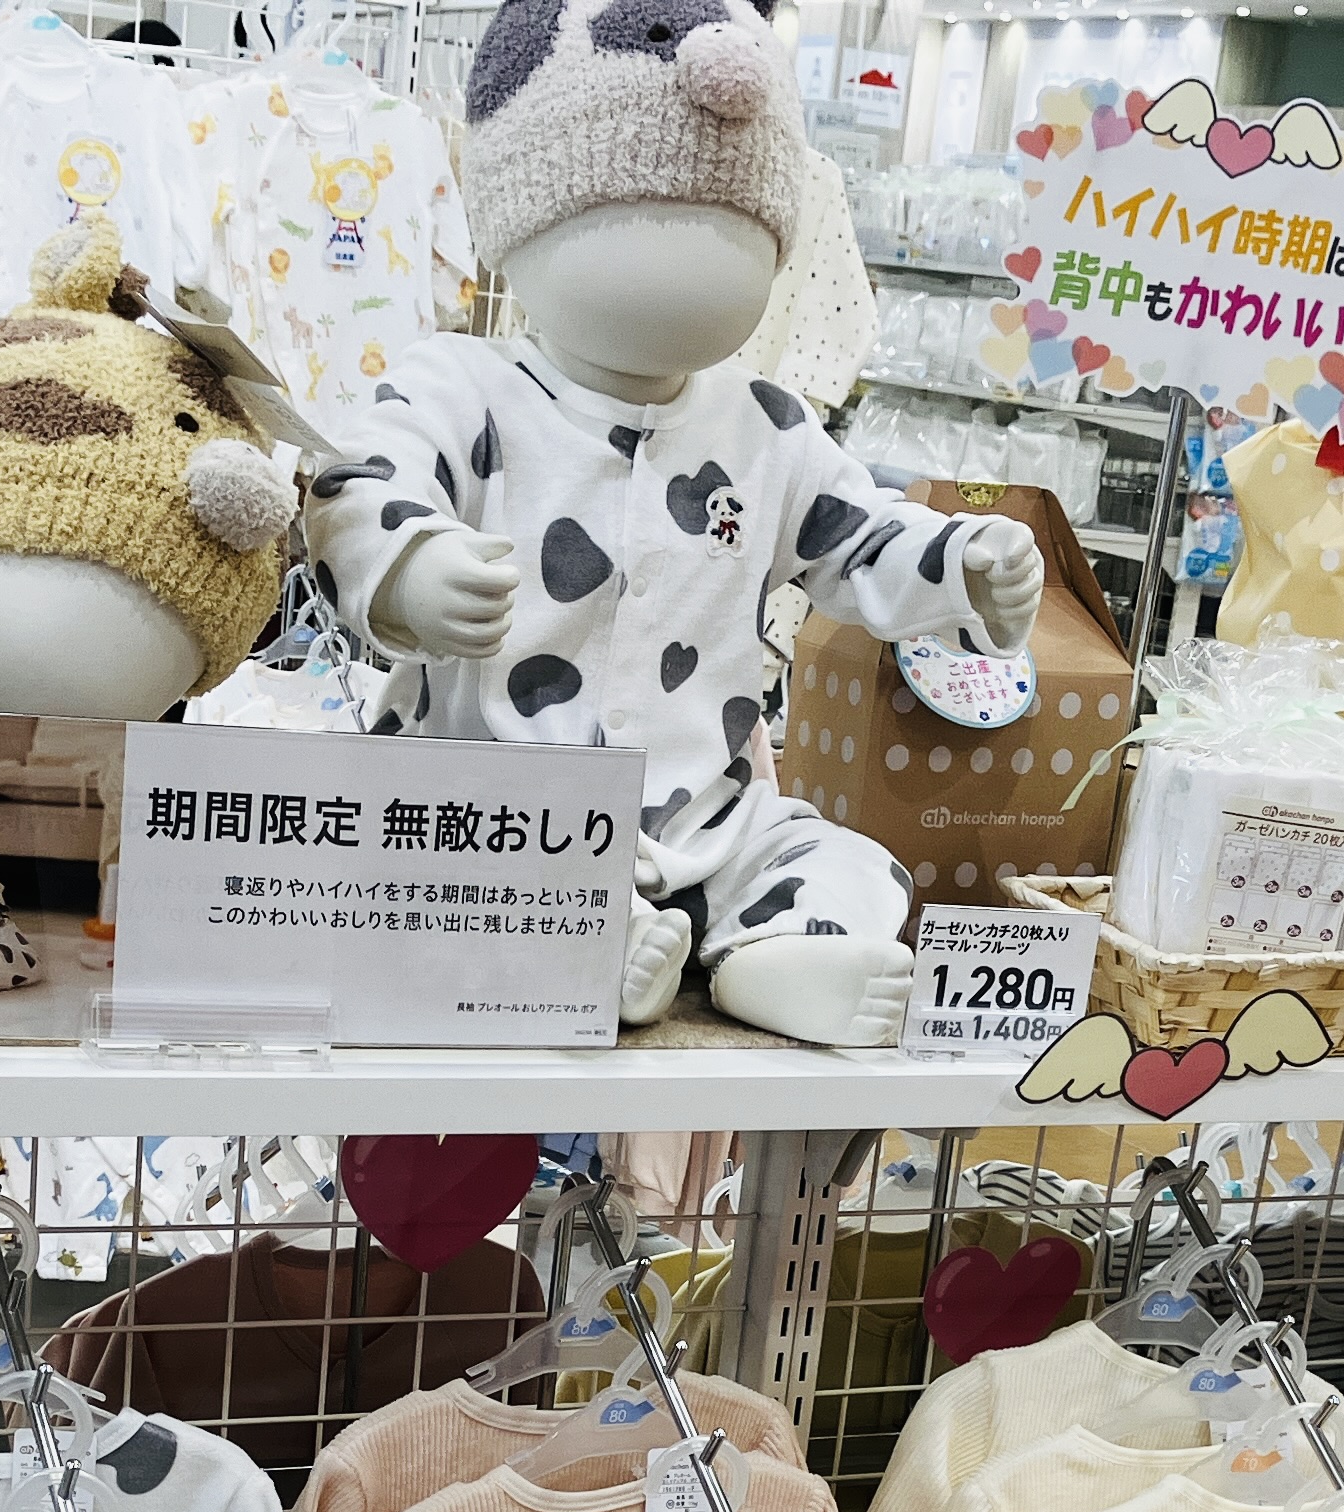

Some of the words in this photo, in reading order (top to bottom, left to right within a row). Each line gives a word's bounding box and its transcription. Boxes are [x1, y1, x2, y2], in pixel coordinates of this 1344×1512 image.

[948, 659, 992, 677] ご出産
[947, 676, 1003, 693] おめでとう
[952, 688, 1008, 705] ございます
[145, 787, 362, 848] 期間限定
[380, 798, 616, 858] 無敵おしり
[953, 811, 1016, 826] akachan
[1020, 811, 1065, 829] honpo
[1234, 820, 1311, 842] ガーゼハンカチ
[223, 875, 609, 909] 寝返りやハイハイをする期間はあっという間
[207, 905, 607, 936] このかわいいおしりを思い出に残しませんか?
[921, 920, 1070, 941] ガーゼハンカチ20枚入り
[920, 938, 1031, 955] アニマル・フルーツ
[933, 964, 1076, 1011] 1,280円
[971, 1015, 1069, 1041] 1,408円
[1198, 1378, 1216, 1391] 80
[609, 1409, 627, 1424] 80
